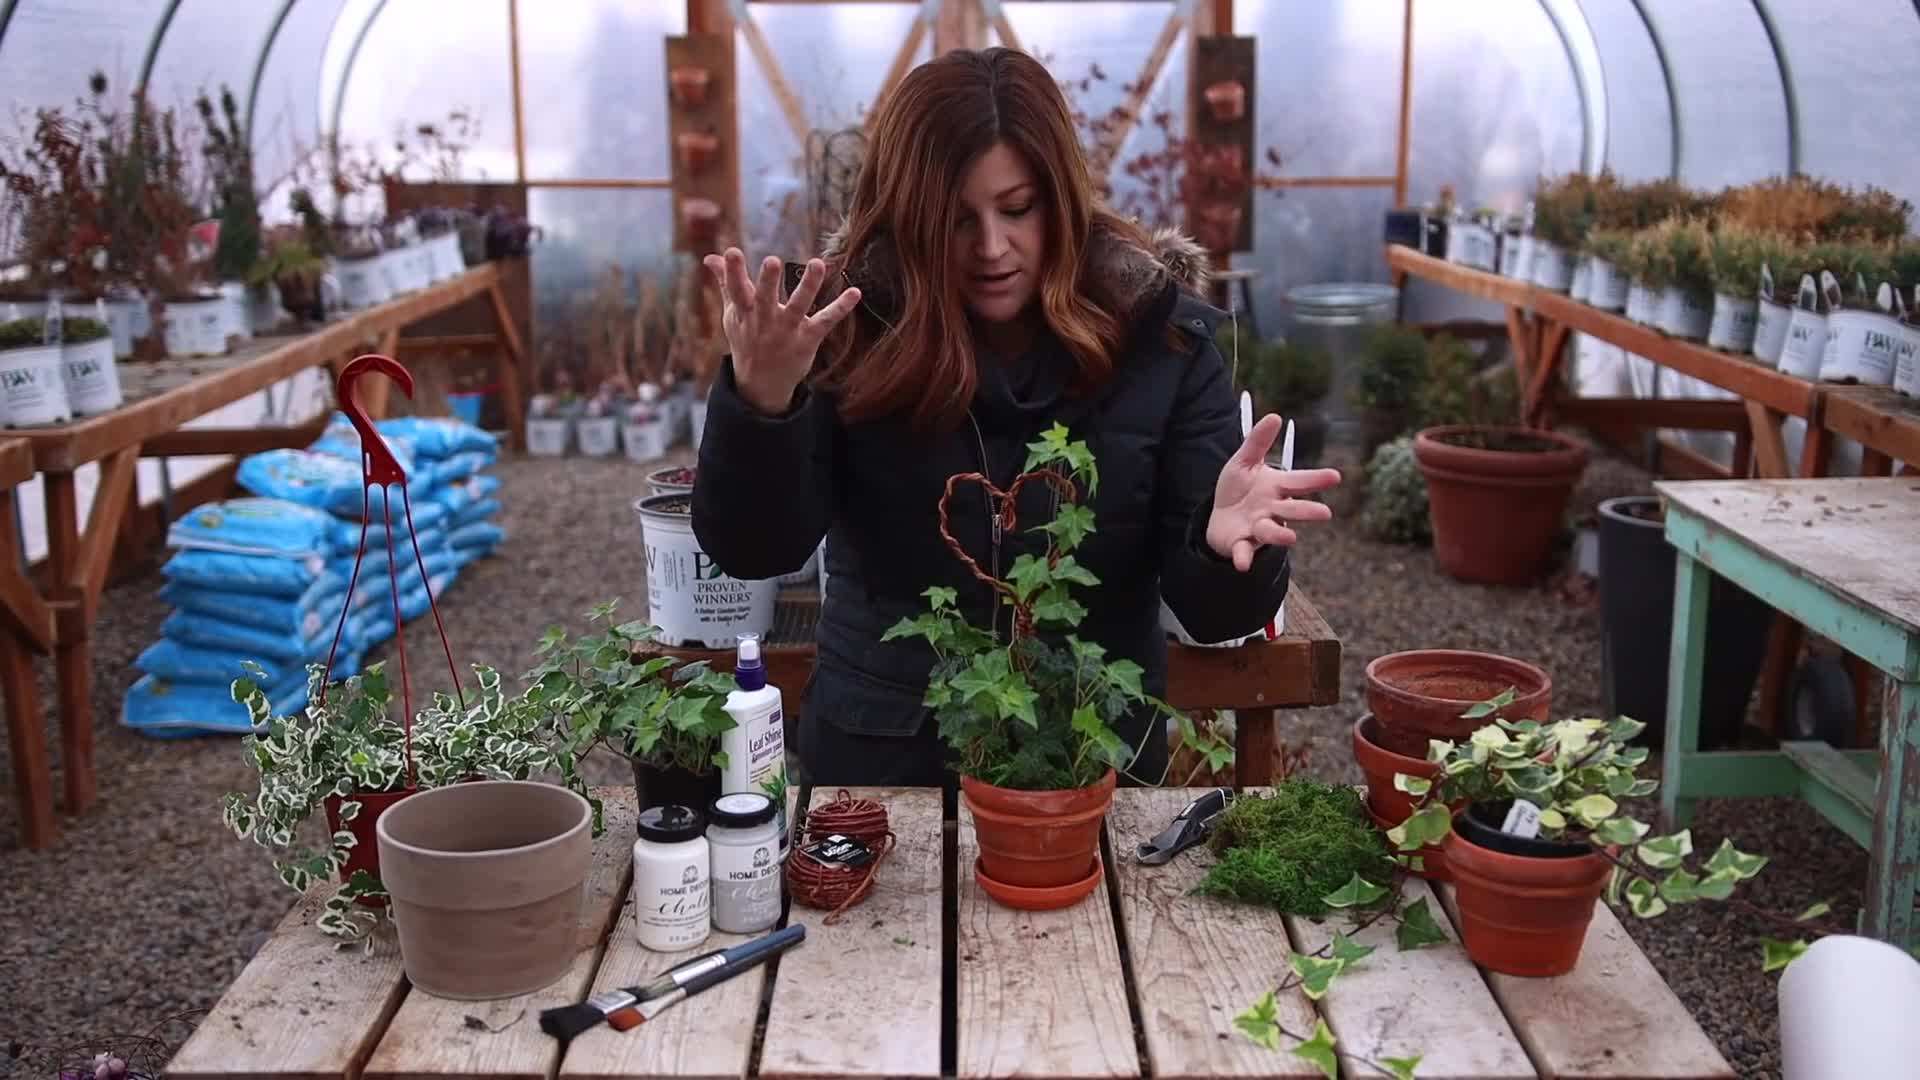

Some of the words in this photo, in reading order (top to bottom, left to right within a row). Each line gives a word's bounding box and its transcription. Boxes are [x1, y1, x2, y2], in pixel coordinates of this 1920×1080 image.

[697, 582, 746, 593] PROVEN
[749, 733, 764, 753] Leaf
[764, 728, 782, 747] Shine
[729, 870, 759, 881] HOME
[660, 886, 687, 896] HOME
